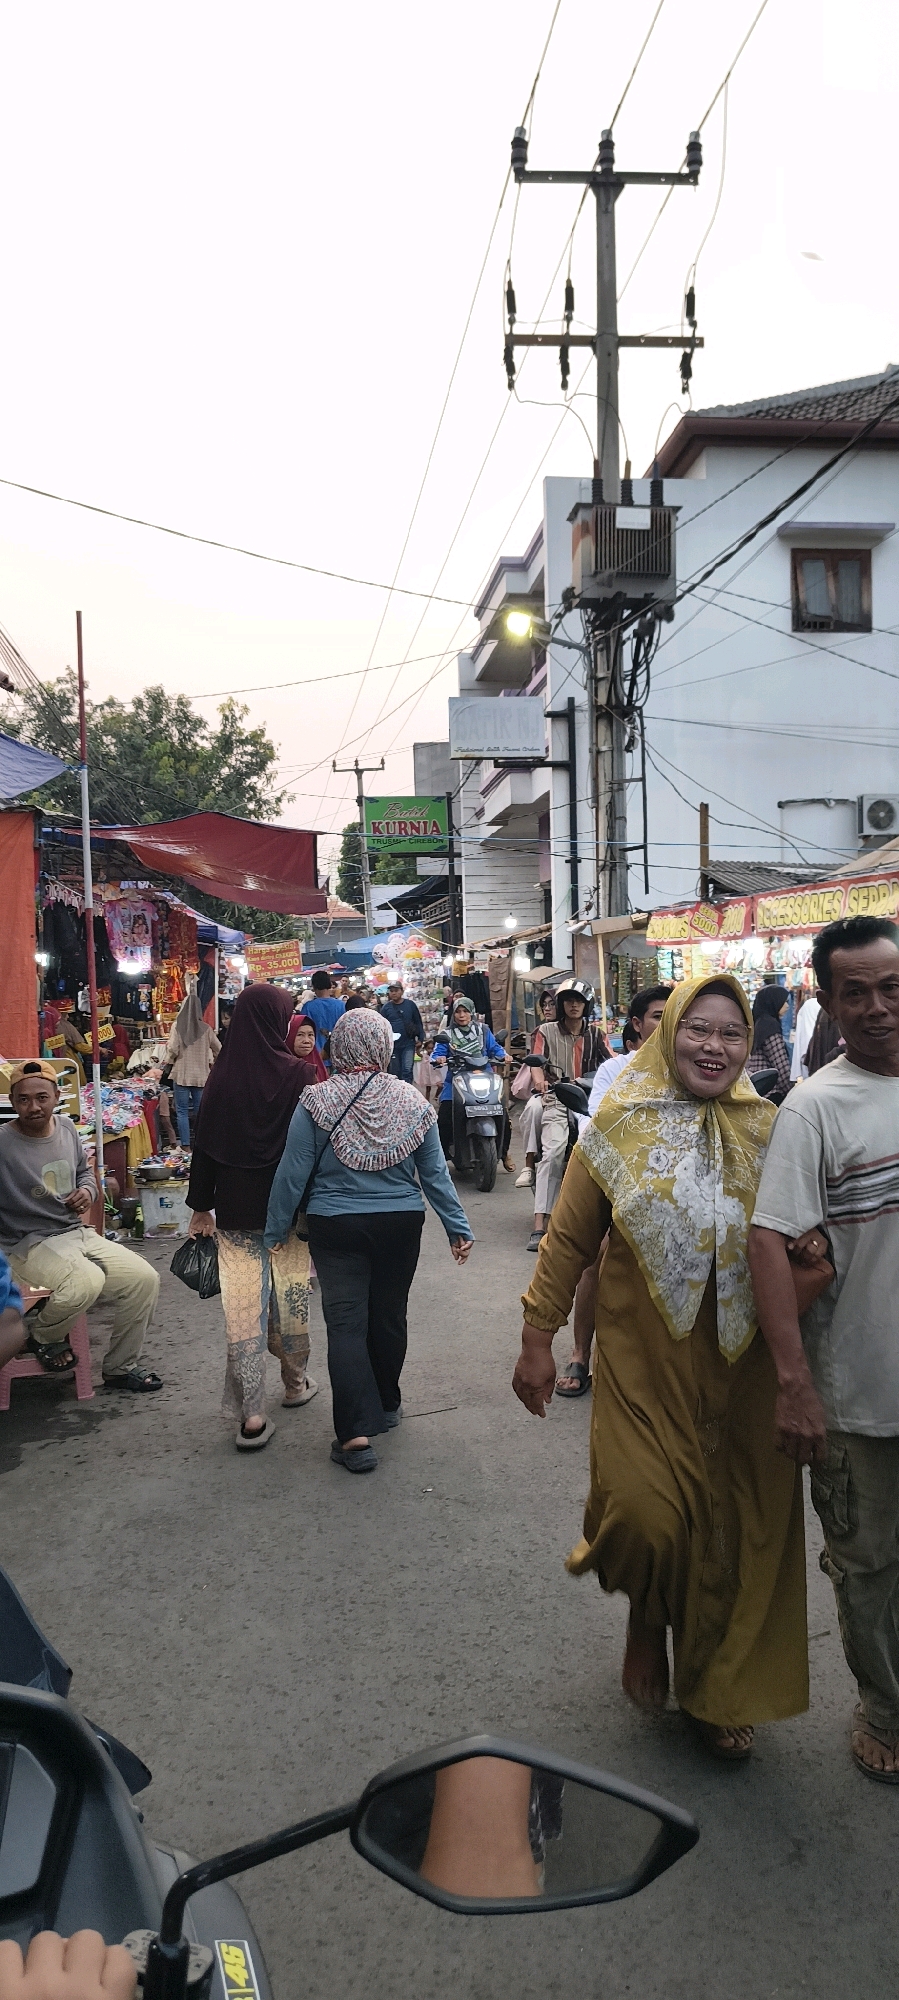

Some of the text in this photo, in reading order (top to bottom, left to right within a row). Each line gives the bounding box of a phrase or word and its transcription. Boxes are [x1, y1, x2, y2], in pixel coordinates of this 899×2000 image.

[371, 819, 443, 836] KURNIA
[756, 888, 844, 930] ACCESSORIES
[692, 912, 719, 937] 5000
[248, 947, 270, 955] Harga
[249, 958, 300, 973] Rp. 35.000
